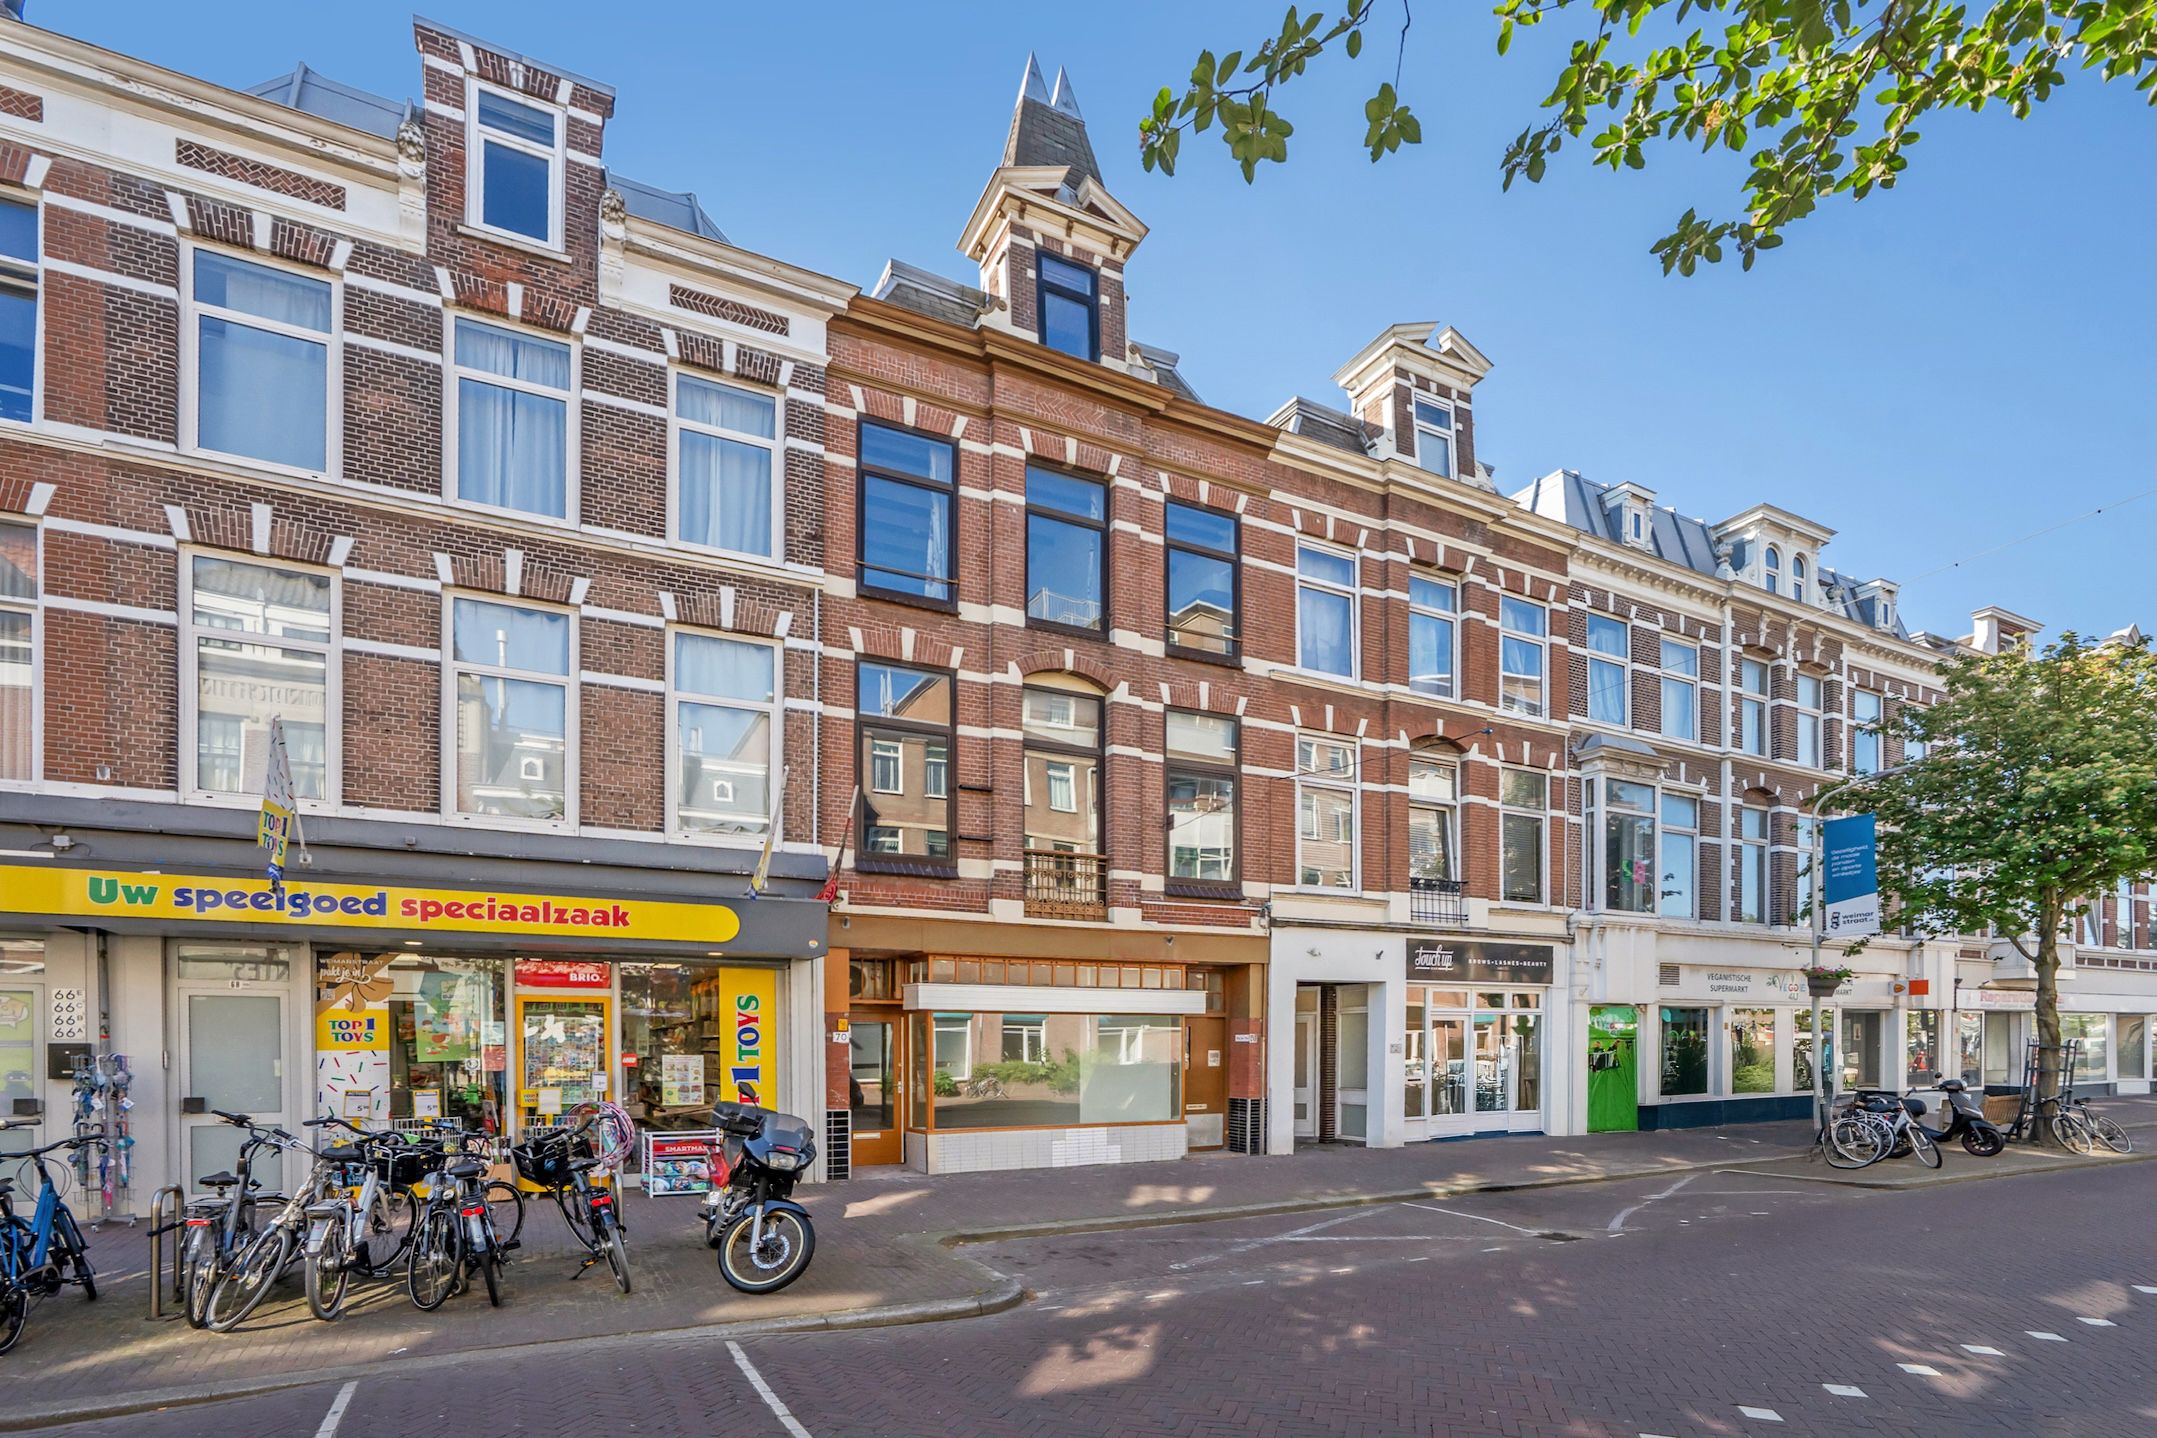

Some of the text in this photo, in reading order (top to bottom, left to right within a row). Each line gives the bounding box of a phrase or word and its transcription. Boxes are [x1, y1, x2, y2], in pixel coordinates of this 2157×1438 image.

[88, 876, 630, 927] Uw speelgoed speciaalzaak
[1415, 944, 1453, 971] Touch up
[569, 973, 600, 982] BRIO
[1707, 973, 1751, 982] VEGANISTISCHE
[1710, 985, 1748, 993] SUPERMARKT
[328, 1018, 375, 1030] TOP 1
[737, 994, 760, 1061] TOYS
[331, 1032, 374, 1042] TOYS
[835, 1032, 848, 1041] 70
